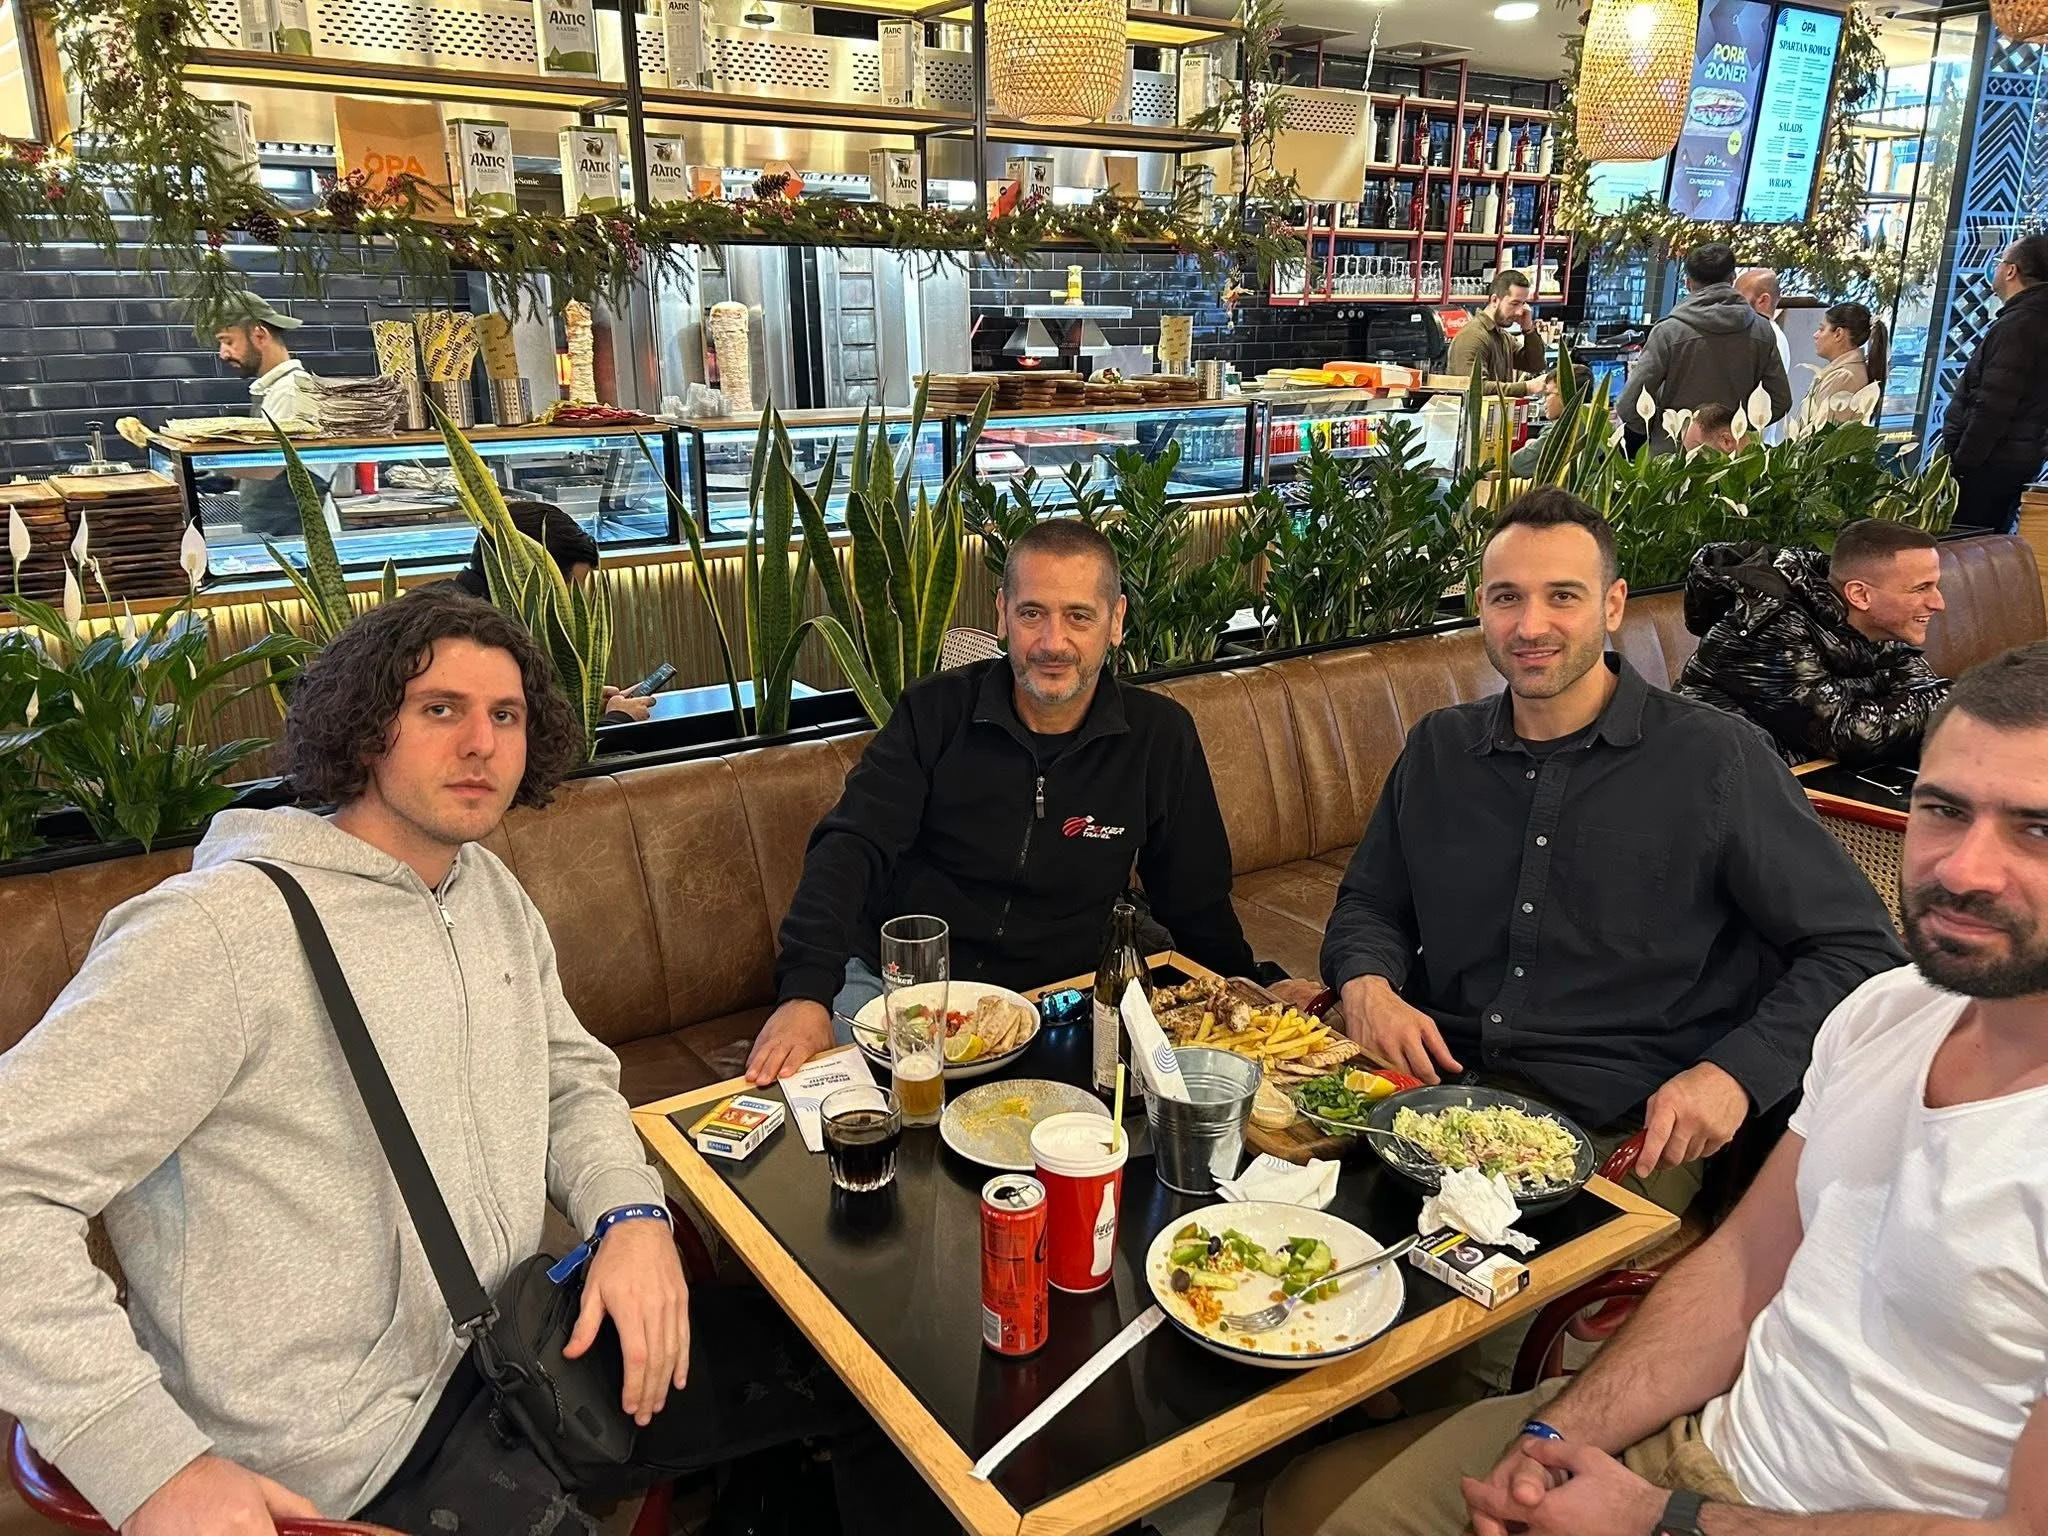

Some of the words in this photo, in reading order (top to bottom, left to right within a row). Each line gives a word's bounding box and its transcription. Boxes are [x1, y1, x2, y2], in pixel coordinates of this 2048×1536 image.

[1713, 41, 1748, 64] PORK
[1778, 39, 1808, 52] SPARTAN
[1808, 43, 1832, 57] BOWLS
[1704, 61, 1748, 83] DONER
[1778, 121, 1803, 133] SALADS
[1768, 178, 1793, 188] WRAPS
[442, 341, 463, 377] BURGER
[1082, 831, 1111, 839] TRAVEL
[1084, 825, 1125, 835] POKER
[1455, 1273, 1484, 1296] Smoking
